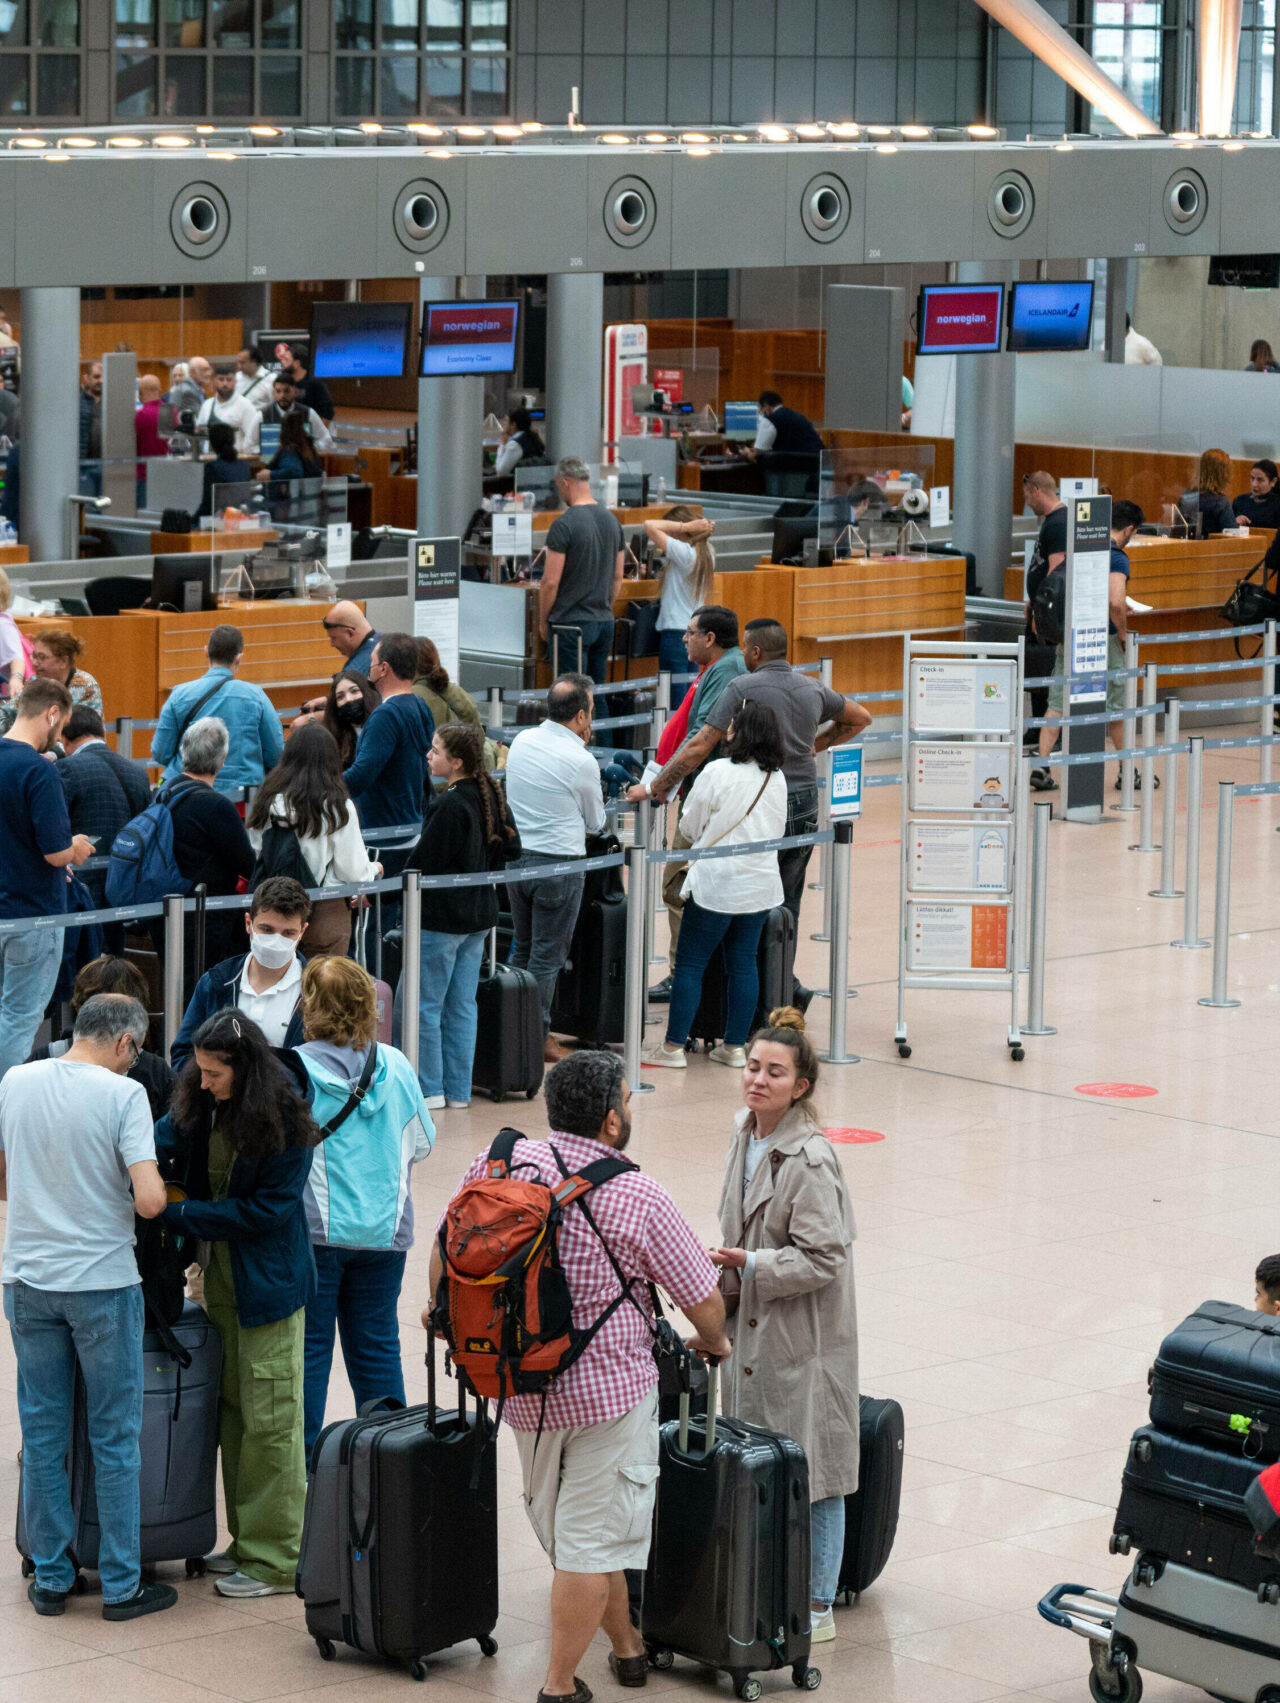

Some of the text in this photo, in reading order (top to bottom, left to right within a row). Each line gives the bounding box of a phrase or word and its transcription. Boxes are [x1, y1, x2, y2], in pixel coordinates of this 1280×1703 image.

[1029, 308, 1068, 316] ICELANDAIR
[937, 313, 986, 325] norwegian
[443, 319, 500, 332] norwegian
[447, 353, 492, 364] Economy Class
[920, 665, 944, 673] Check-in
